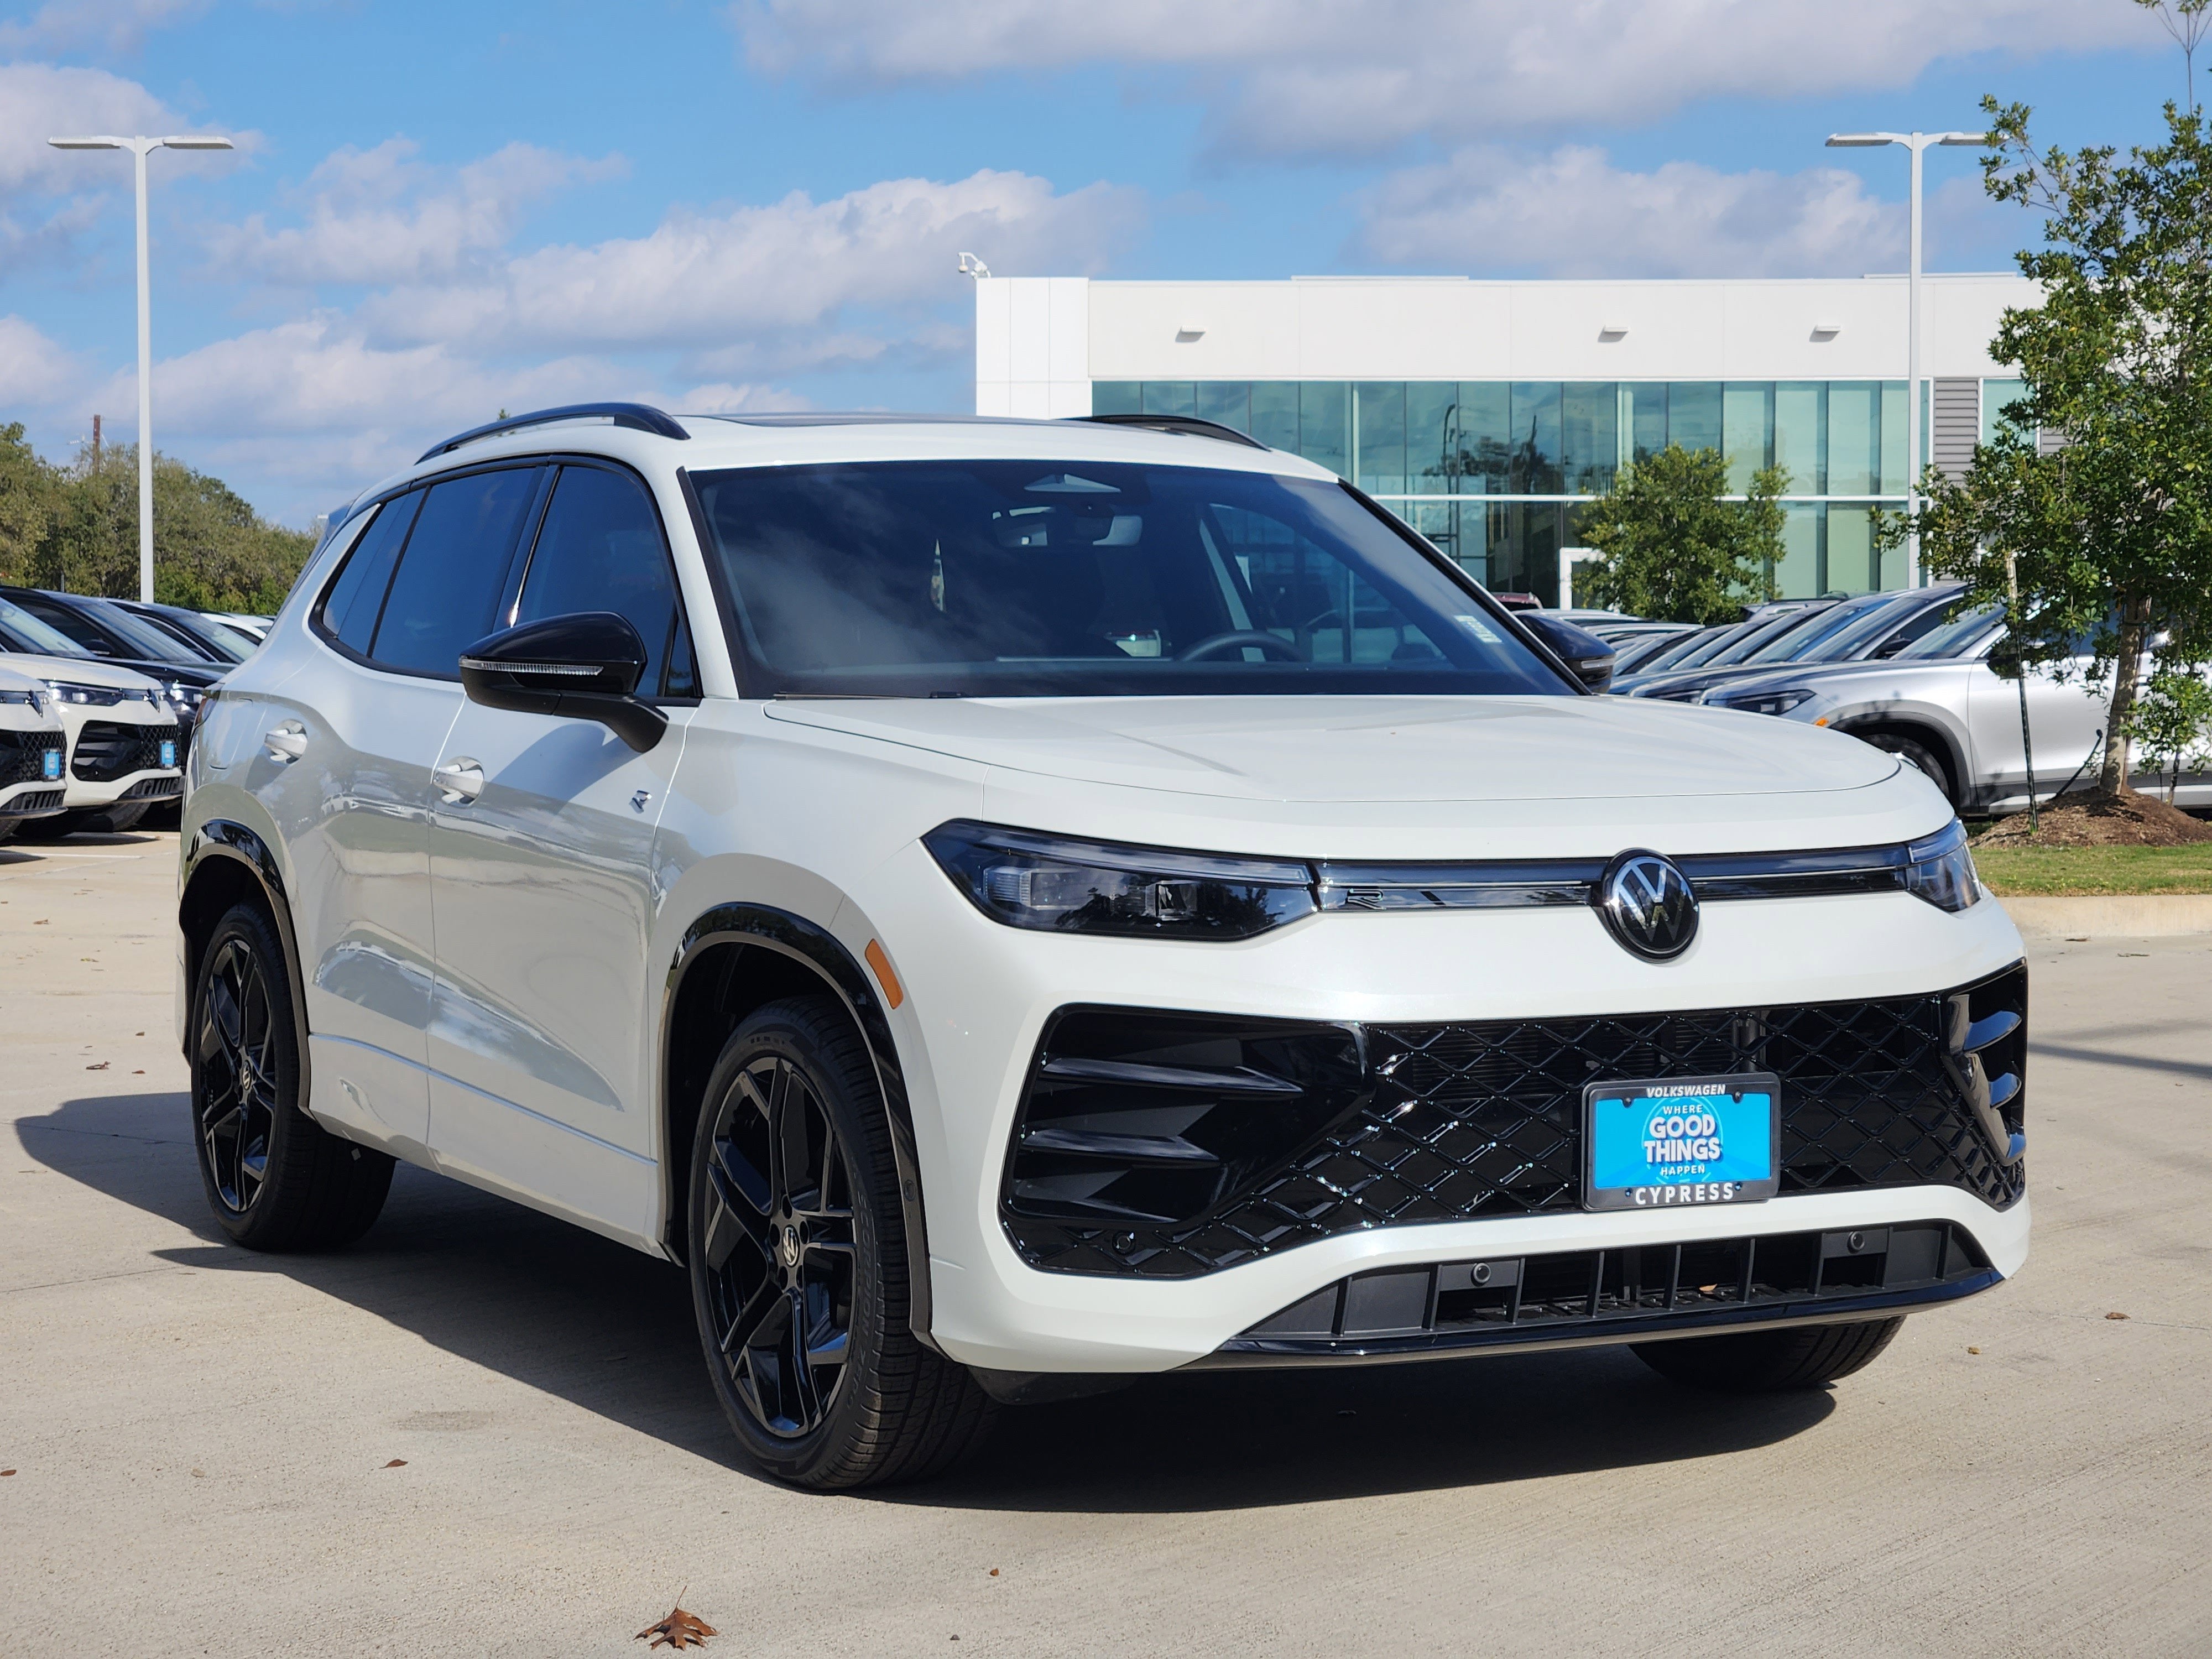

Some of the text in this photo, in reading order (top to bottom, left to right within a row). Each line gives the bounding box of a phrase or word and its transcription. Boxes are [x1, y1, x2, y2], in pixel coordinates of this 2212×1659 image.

[1646, 1084, 1726, 1098] VOLKSWAGEN
[1663, 1104, 1703, 1114] WHERE
[1649, 1114, 1716, 1139] GOOD
[1644, 1137, 1720, 1163] THINGS
[1661, 1165, 1705, 1176] HAPPEN
[1635, 1182, 1734, 1205] CYPRESS
[847, 1188, 872, 1410] SCORPION ZERO
